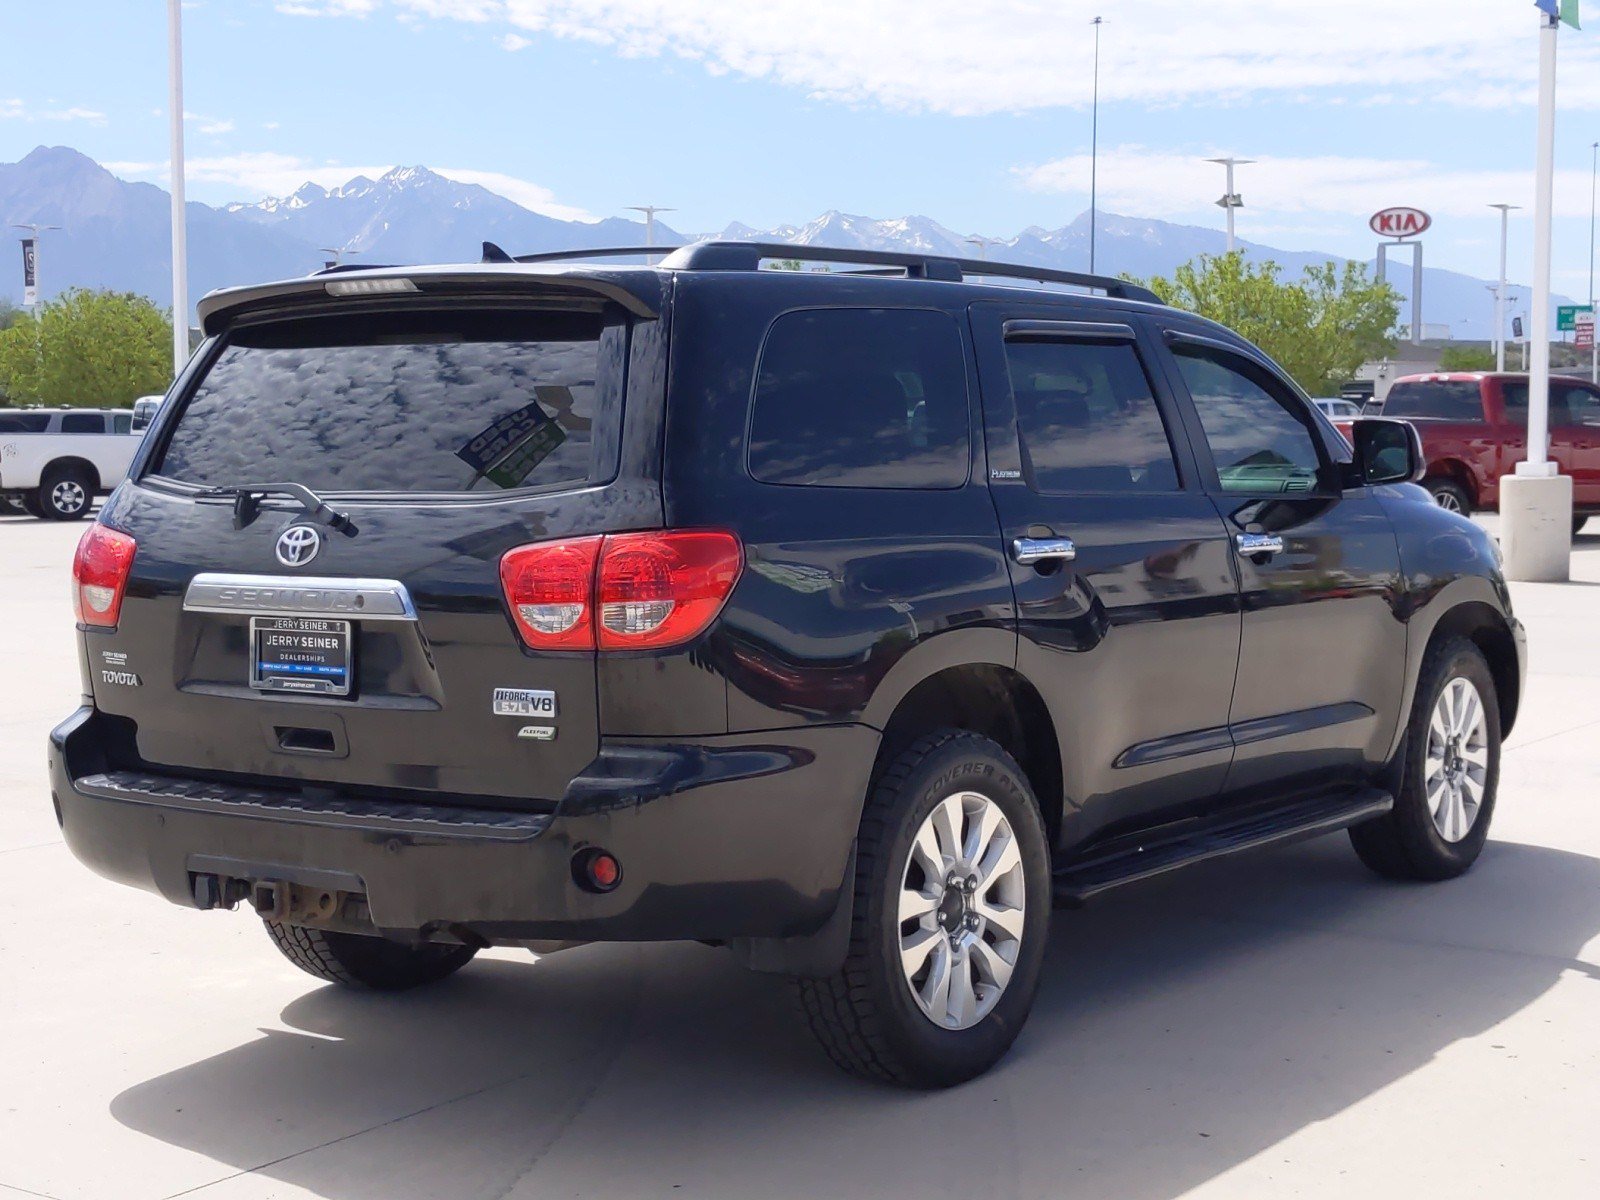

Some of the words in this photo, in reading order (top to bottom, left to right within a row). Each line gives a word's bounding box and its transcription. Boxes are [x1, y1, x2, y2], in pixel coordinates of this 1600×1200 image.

[1380, 213, 1419, 232] KIA
[273, 620, 299, 629] JERRY
[299, 621, 328, 631] SEINER
[266, 635, 300, 647] JERRY
[301, 638, 339, 649] SEINER
[280, 654, 325, 663] DEALERSHIPS
[102, 670, 138, 686] TOYOTA
[531, 697, 552, 711] V8
